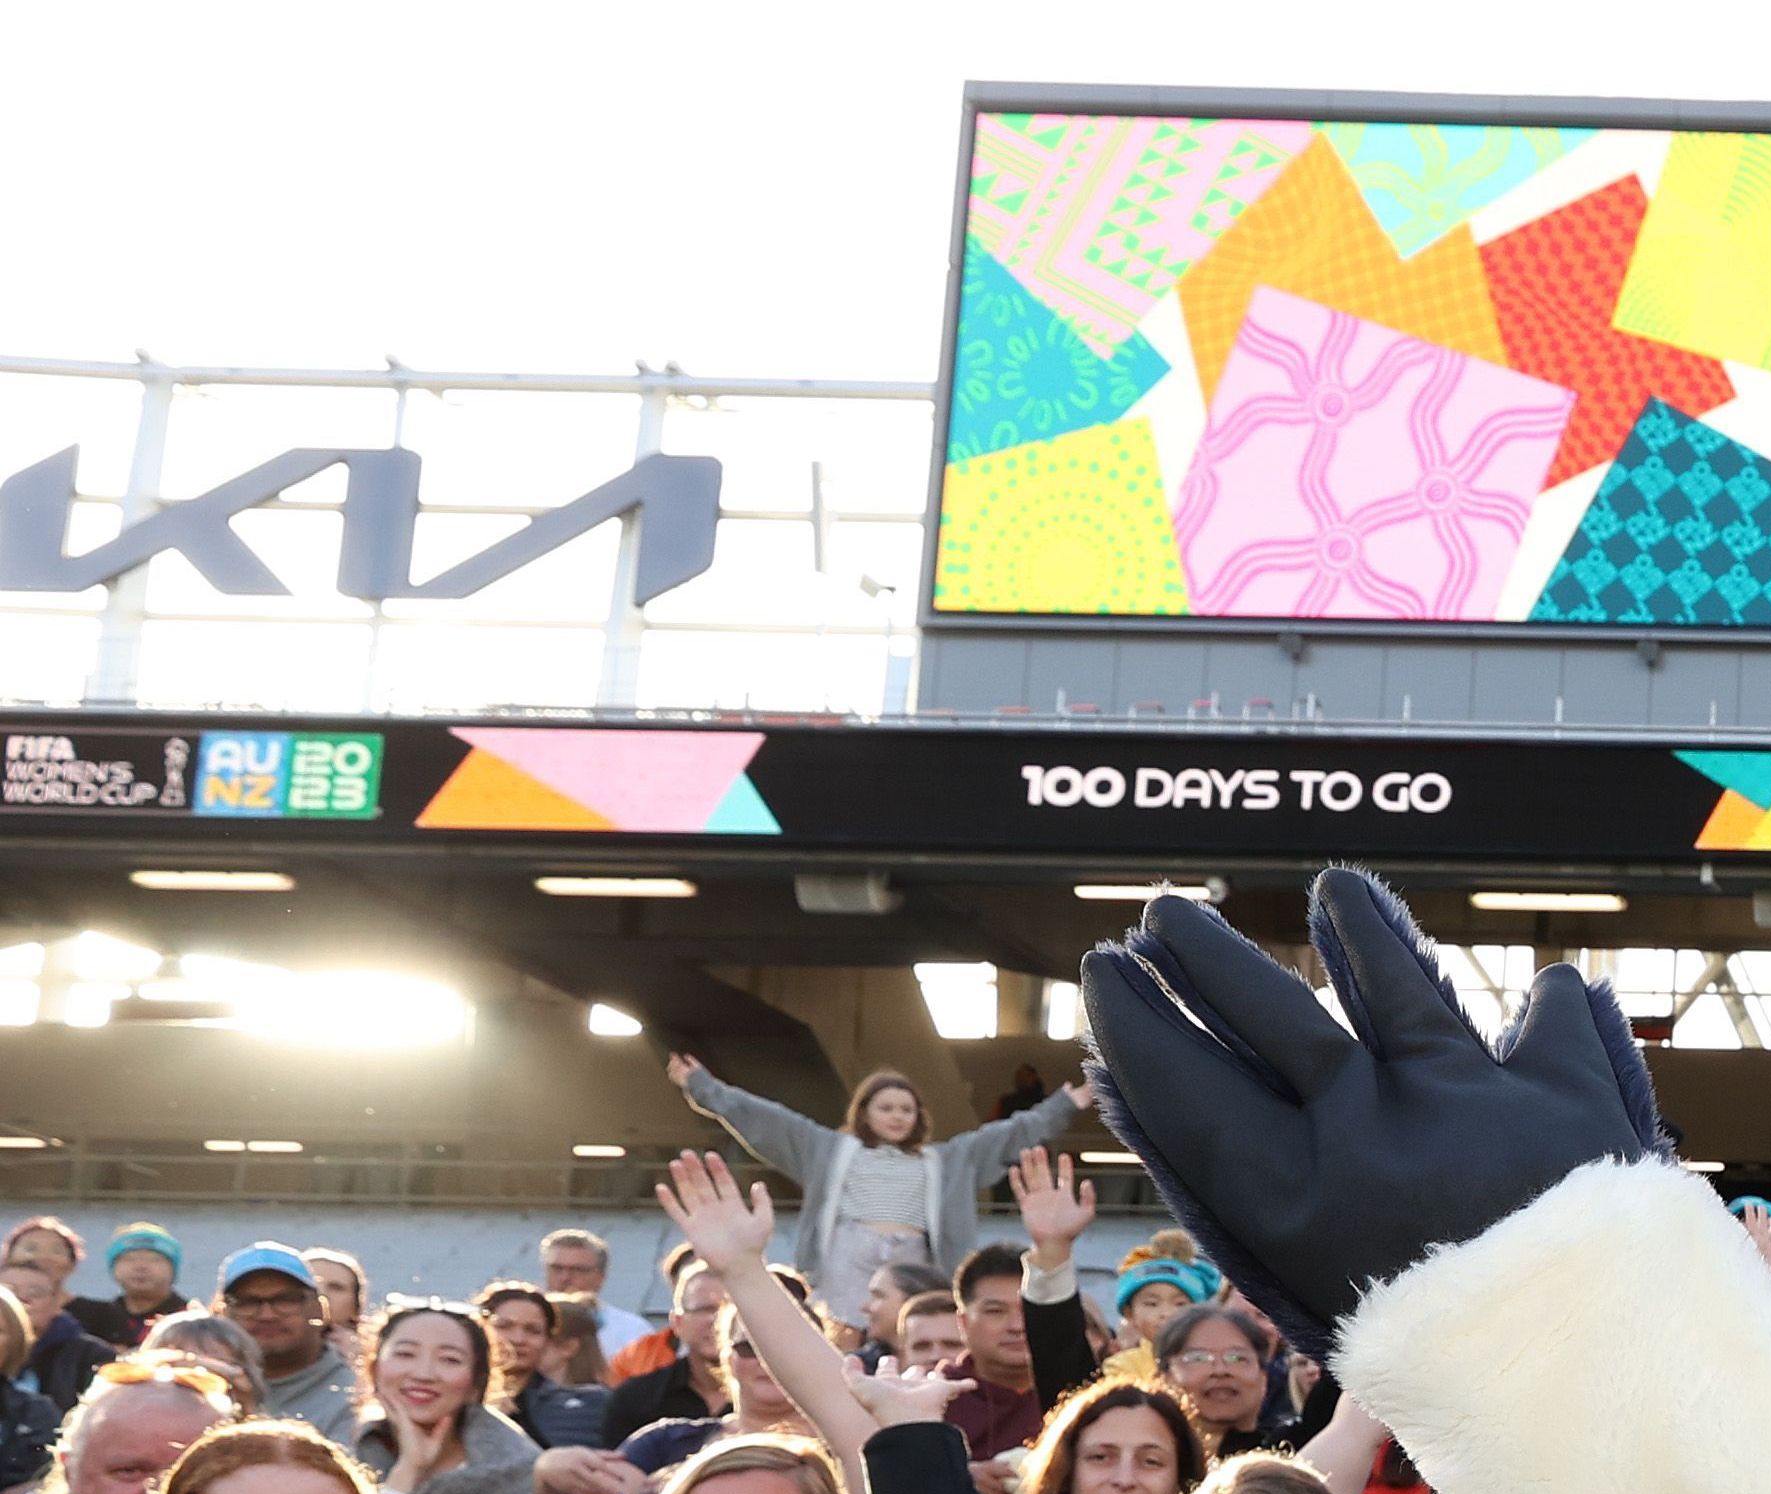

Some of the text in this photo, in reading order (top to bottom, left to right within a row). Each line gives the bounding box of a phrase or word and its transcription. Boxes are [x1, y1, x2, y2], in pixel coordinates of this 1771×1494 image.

[5, 735, 76, 760] FIFA
[205, 739, 281, 774] AU
[293, 740, 373, 776] 20
[2, 781, 158, 806] WORLD CUP
[203, 775, 279, 809] NZ
[288, 776, 368, 811] 23
[1021, 764, 1452, 815] 100 DAYS TO GO
